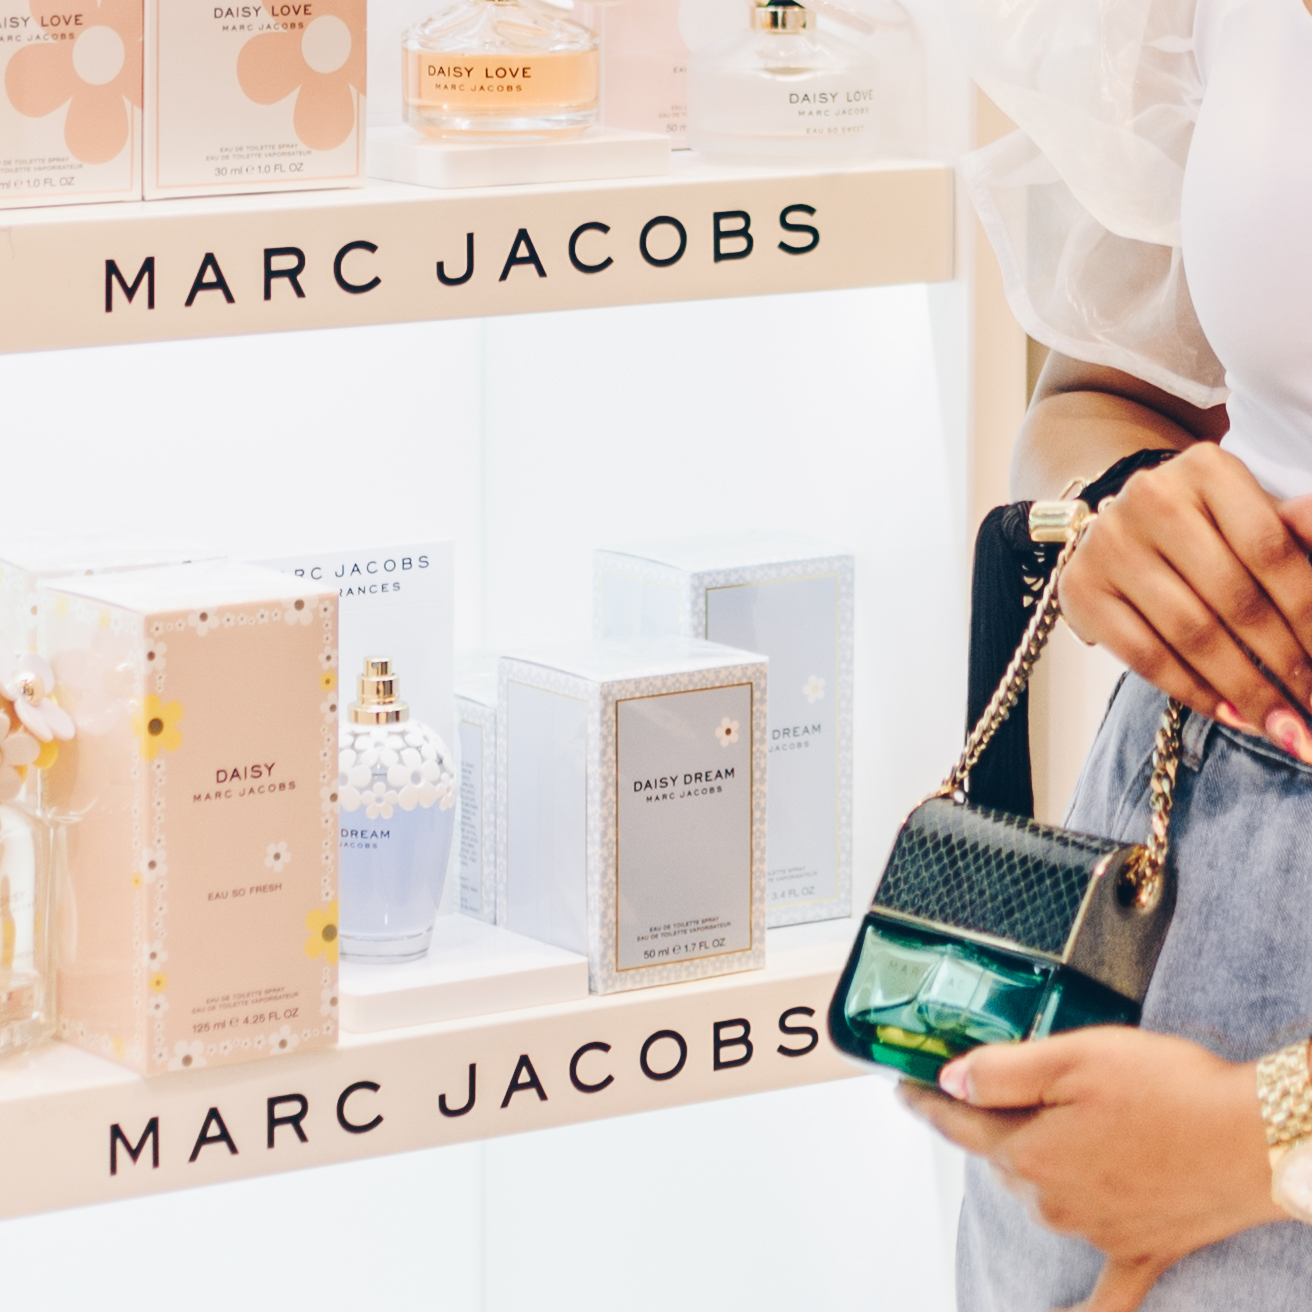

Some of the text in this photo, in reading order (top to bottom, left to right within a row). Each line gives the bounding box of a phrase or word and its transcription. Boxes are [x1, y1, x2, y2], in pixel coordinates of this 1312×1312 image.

[214, 3, 313, 19] DAISY LOVE
[40, 14, 84, 28] LOVE
[222, 22, 304, 33] MARC JACOBS
[27, 32, 75, 42] JACOBS
[428, 65, 532, 79] DAISY LOVE
[435, 83, 523, 93] MARC JACOBS
[789, 88, 874, 105] DAISY LOVE
[214, 162, 304, 177] 30 ml 1.0 FL OZ
[26, 178, 41, 188] 1.0
[43, 177, 56, 187] FL
[59, 176, 75, 187] OZ
[104, 203, 821, 314] MARC JACOBS
[294, 555, 430, 580] RC JACOBS
[340, 582, 401, 598] ANCES
[772, 723, 822, 741] DREAM
[768, 741, 810, 753] JACOBS
[216, 762, 276, 784] DAISY
[633, 767, 736, 793] DAISY DREAM
[193, 780, 297, 803] MARC JACOBS
[646, 785, 723, 803] MARC JACOBS
[340, 828, 390, 839] DREAM
[208, 883, 283, 901] EAU SO FRESH
[801, 885, 815, 896] OZ
[643, 937, 726, 960] 50 ml 1.7 FL OZ
[192, 1022, 211, 1034] 125
[243, 1013, 266, 1025] 4.25
[268, 1011, 281, 1022] FL
[283, 1007, 299, 1019] OZ
[108, 1005, 821, 1177] MARC JACOBS
